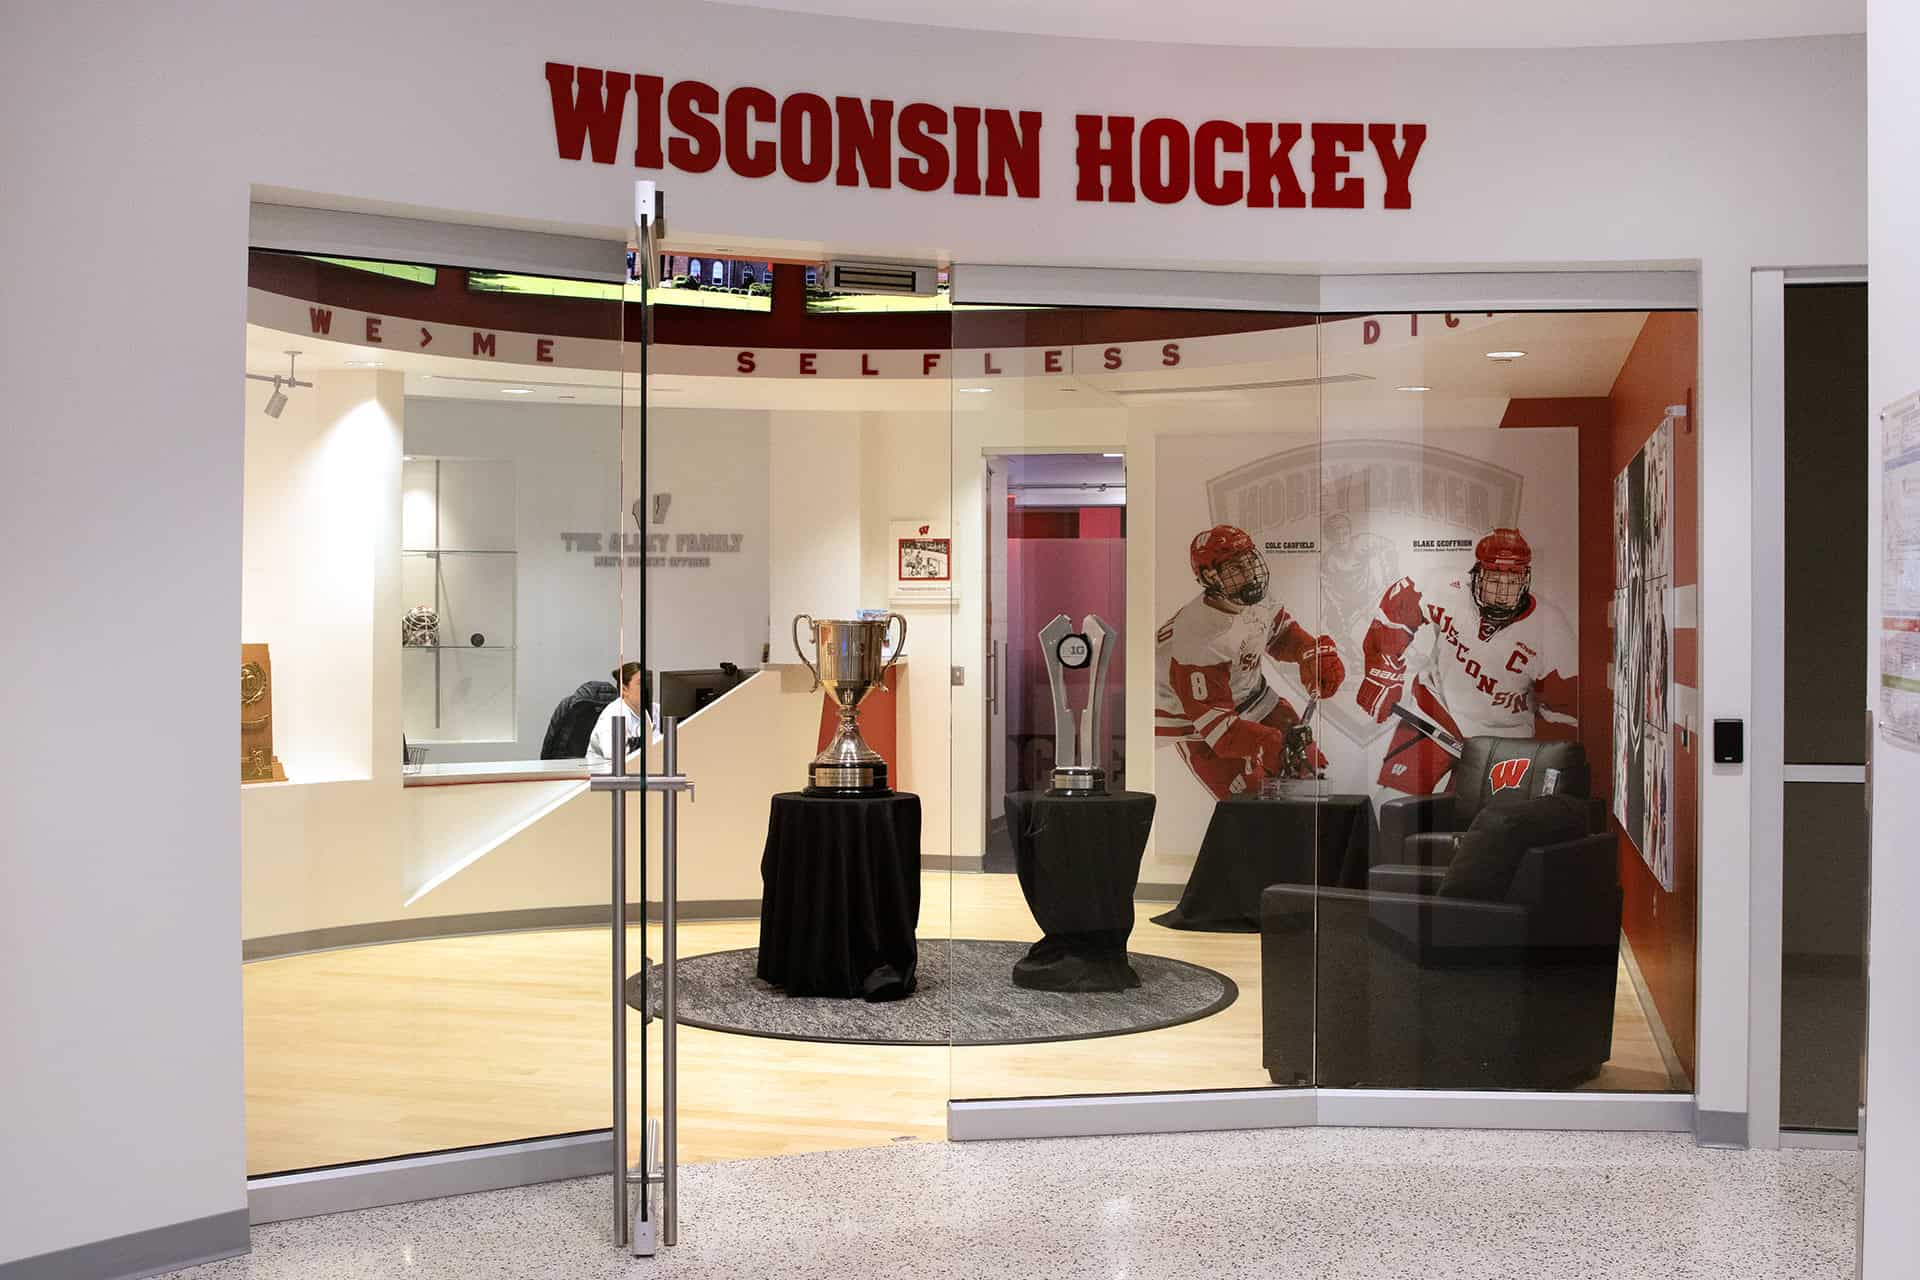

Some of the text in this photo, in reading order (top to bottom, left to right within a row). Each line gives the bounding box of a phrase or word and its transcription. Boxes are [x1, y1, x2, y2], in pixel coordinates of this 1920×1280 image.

[545, 62, 1428, 210] WISCONSIN HOCKEY
[736, 343, 1182, 376] SELFLESS
[676, 533, 744, 552] FAMILY
[1427, 603, 1529, 714] WISCONSIN
[1505, 650, 1528, 674] C
[1489, 758, 1531, 795] W
